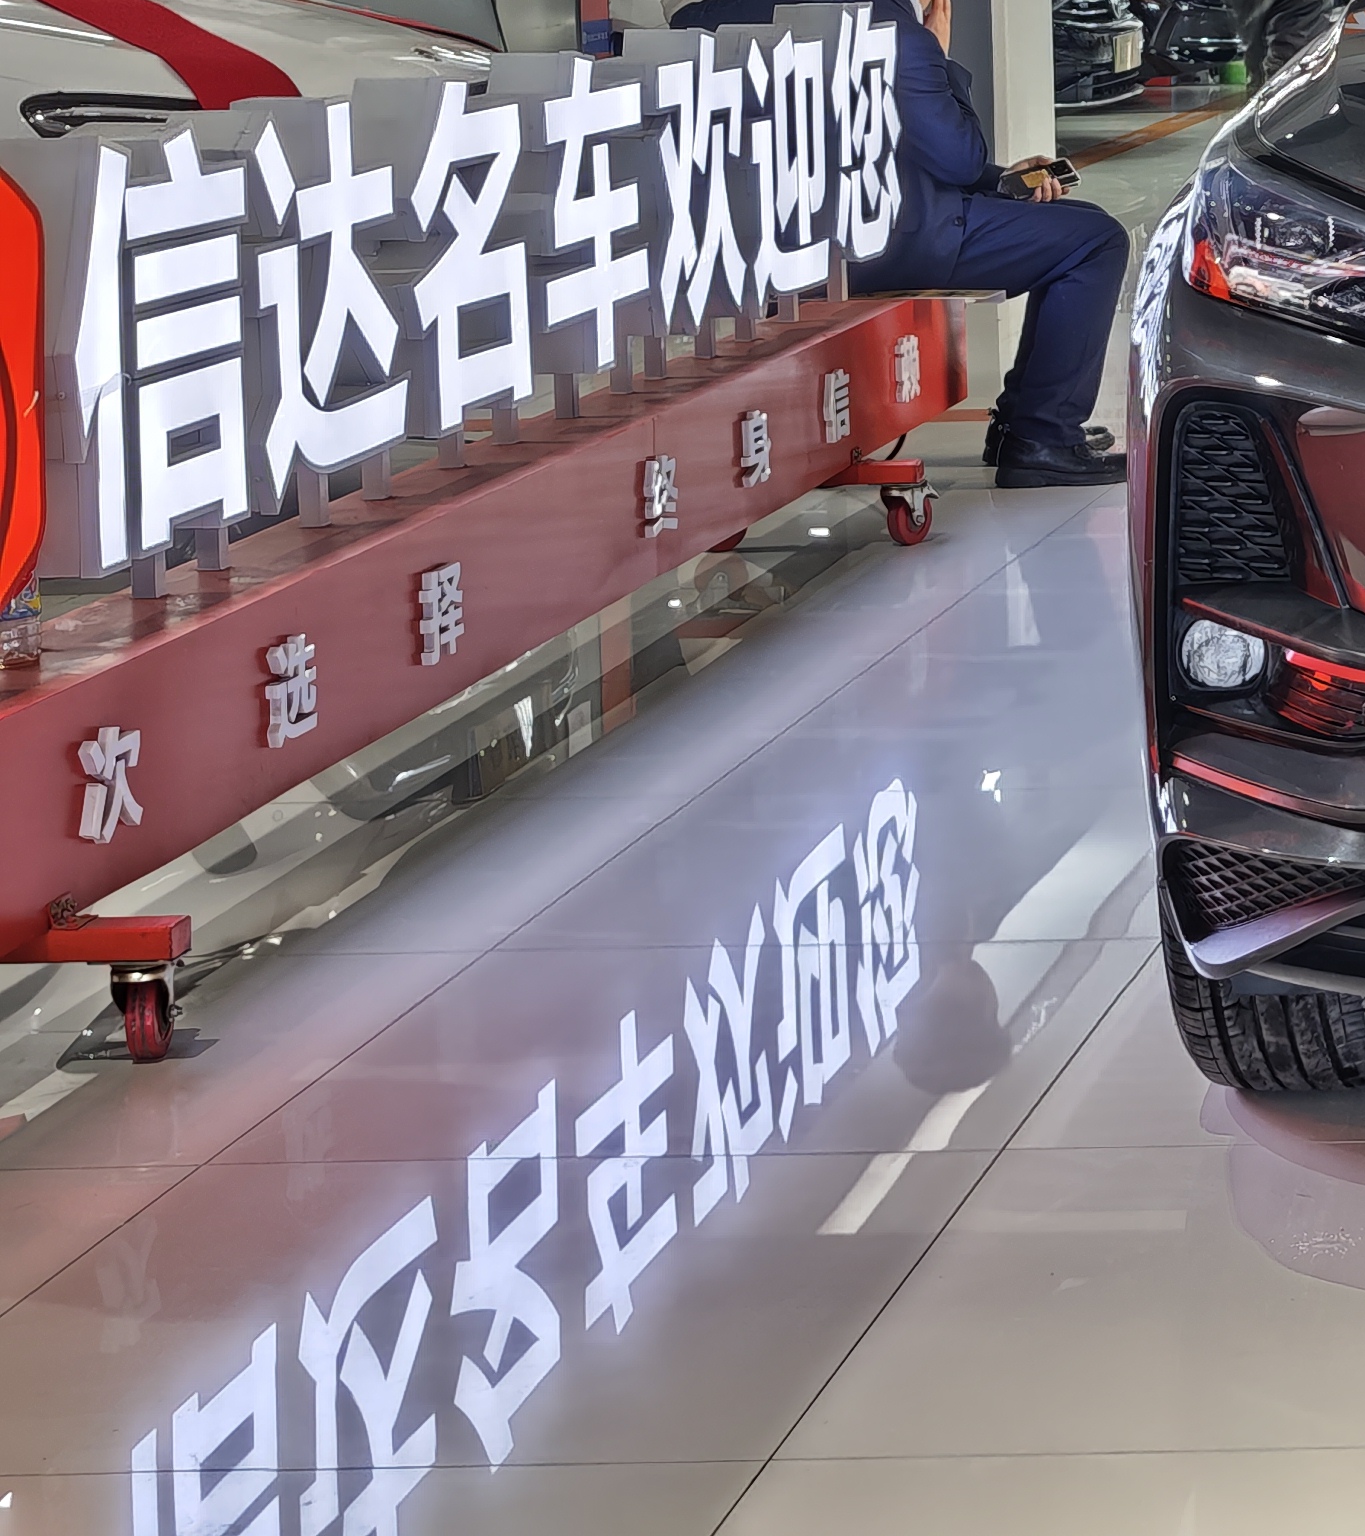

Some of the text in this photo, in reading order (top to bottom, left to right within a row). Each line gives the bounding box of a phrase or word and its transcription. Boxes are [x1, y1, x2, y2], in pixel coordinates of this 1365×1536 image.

[75, 2, 903, 572] 信达名车欢迎您
[642, 334, 923, 540] 终身信赖
